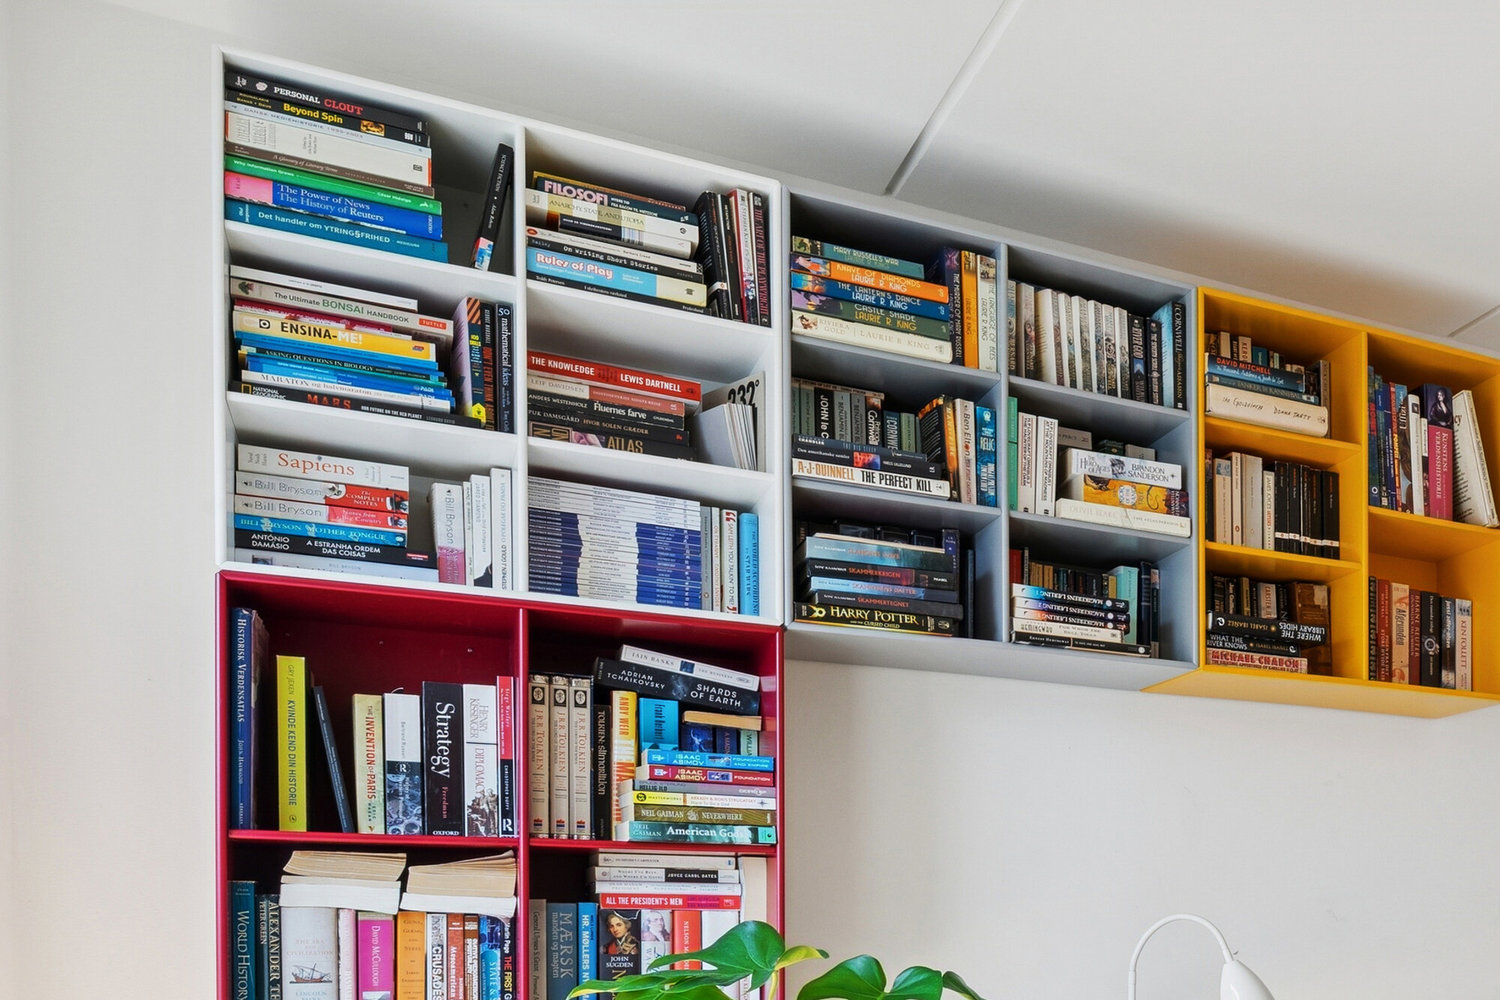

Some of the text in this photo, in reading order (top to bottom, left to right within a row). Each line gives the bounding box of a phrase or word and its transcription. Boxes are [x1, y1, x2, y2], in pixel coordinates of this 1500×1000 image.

[273, 86, 320, 104] PERSONAL
[324, 98, 363, 115] CLOUT
[283, 103, 343, 125] Beyond Spin
[277, 184, 370, 211] The Power of News
[544, 180, 608, 206] FILOSOFI
[277, 193, 384, 223] The History of Reuters
[258, 211, 273, 221] Det
[275, 214, 307, 228] handler
[309, 222, 322, 231] om
[536, 253, 569, 269] Rules
[571, 261, 584, 272] of
[586, 263, 615, 281] Play
[836, 264, 921, 293] KNAVE OF DIAMONDS LAURIE KING
[274, 292, 288, 301] The
[289, 295, 320, 307] Ultimate
[322, 299, 364, 315] BONSAI
[367, 310, 409, 323] HANDBOOK
[838, 282, 922, 311] THE LANTERN'S DANCE LAURIE KING
[855, 304, 918, 331] CASTLE SHADE LAURIE KING
[531, 357, 681, 393] THE KNOWLEDGE LEWIS DARTNELL
[1216, 357, 1271, 375] DAVID MITCHELL
[307, 394, 352, 410] MARS
[278, 453, 354, 477] Sapiens
[255, 480, 322, 496] Bill Bryson
[861, 470, 875, 484] THE
[879, 472, 913, 489] PERFECT
[916, 477, 932, 493] KILL
[255, 500, 322, 517] Bill Bryson
[445, 496, 455, 545] Bill Bryson
[251, 534, 290, 551] ANTÓNIO DAMÁSIO
[314, 541, 353, 551] ESTRANHA
[354, 545, 381, 554] ORDEM
[322, 547, 366, 558] DAS COISAS
[830, 606, 919, 630] HARRY POTTER CURSED CHILD
[1207, 634, 1248, 651] WHAT THE RIVER KNOWS
[1279, 621, 1326, 642] WHERE THE LIBRARY HIDES
[1211, 650, 1300, 669] MICHAEL CHABON
[607, 672, 665, 690] TCHAIKOVSKY
[621, 670, 653, 682] ADRIAN
[690, 683, 742, 709] SHARDS OF EARTH
[431, 702, 455, 779] Strategy
[287, 699, 298, 807] KVINDE KEND DIN HISTORIE
[641, 810, 744, 821] NEIL GAIMAN NEVERWHERE
[606, 896, 616, 906] ALL
[618, 896, 629, 906] THE
[631, 896, 669, 906] PRESIDENT'S
[670, 897, 683, 907] MEN
[237, 911, 250, 953] WORLD
[268, 901, 280, 982] ALEXANDER
[551, 913, 574, 979] MÆRSK manden og magten
[606, 955, 634, 969] JOHN SUGDEN
